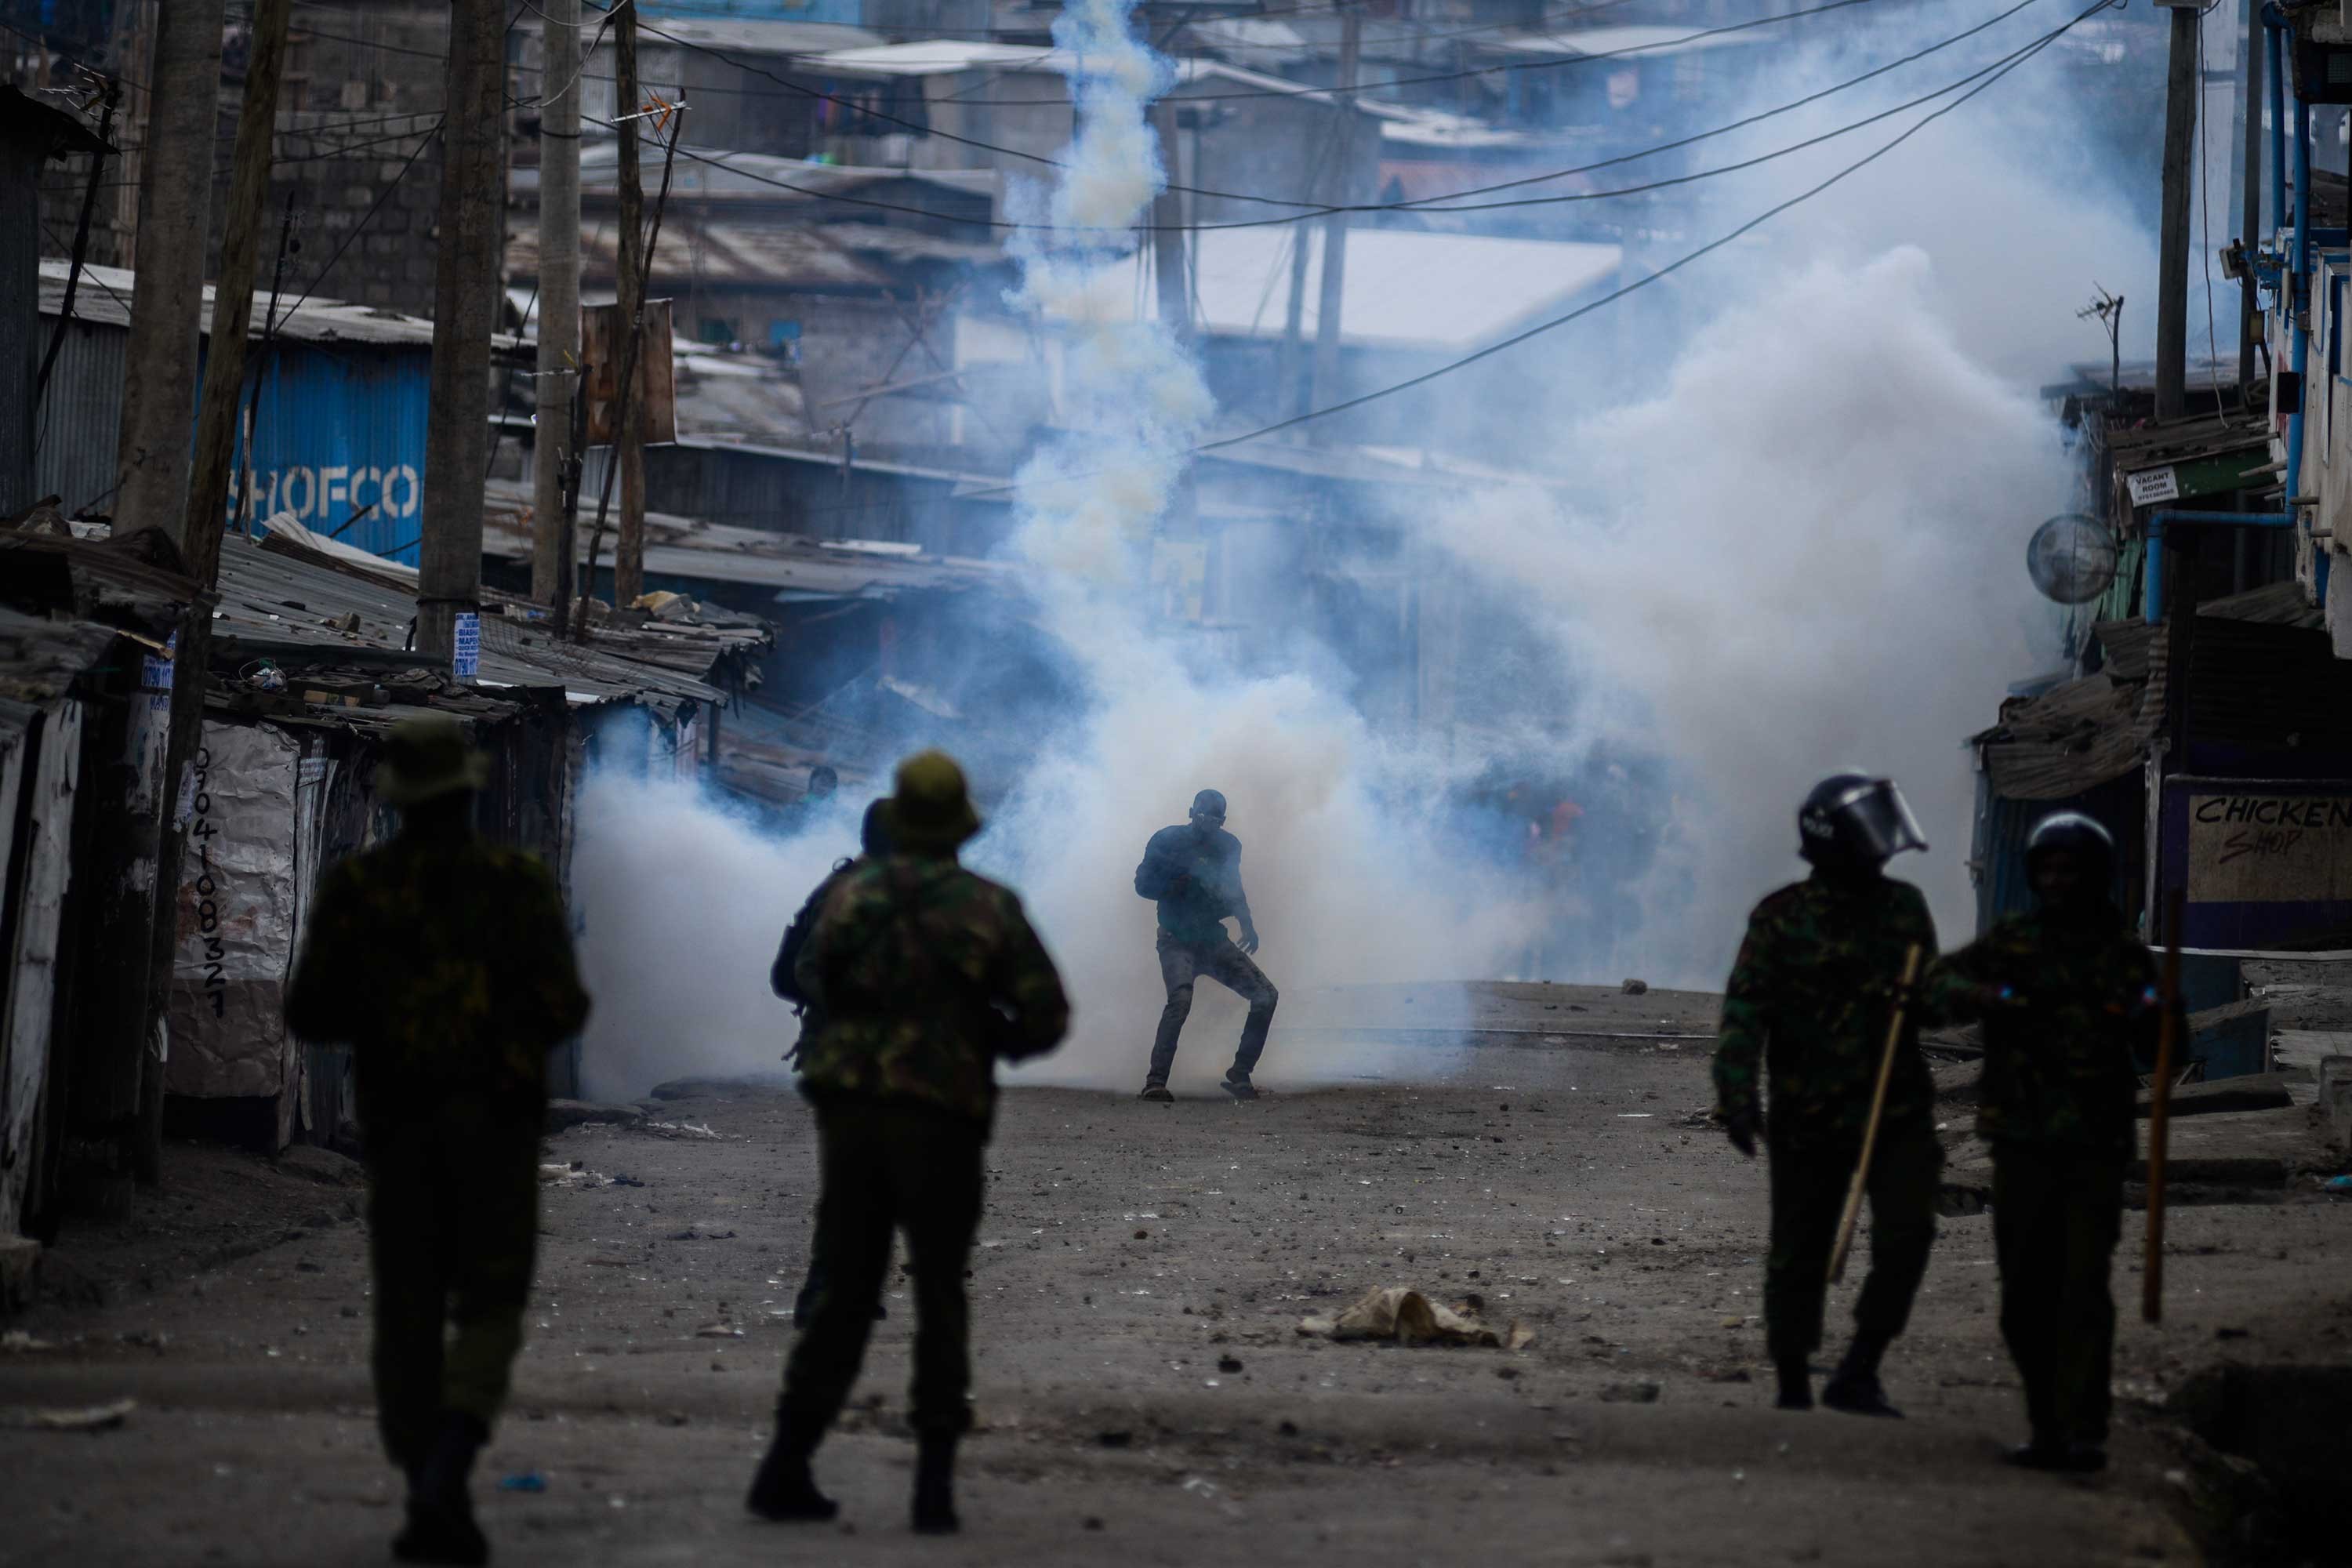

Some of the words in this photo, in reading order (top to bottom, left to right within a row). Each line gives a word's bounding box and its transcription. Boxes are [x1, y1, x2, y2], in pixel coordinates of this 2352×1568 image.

[2136, 472, 2169, 485] VACANT
[2143, 481, 2167, 492] ROOM
[2196, 797, 2352, 828] CHICKEN
[2218, 829, 2303, 864] SHOP
